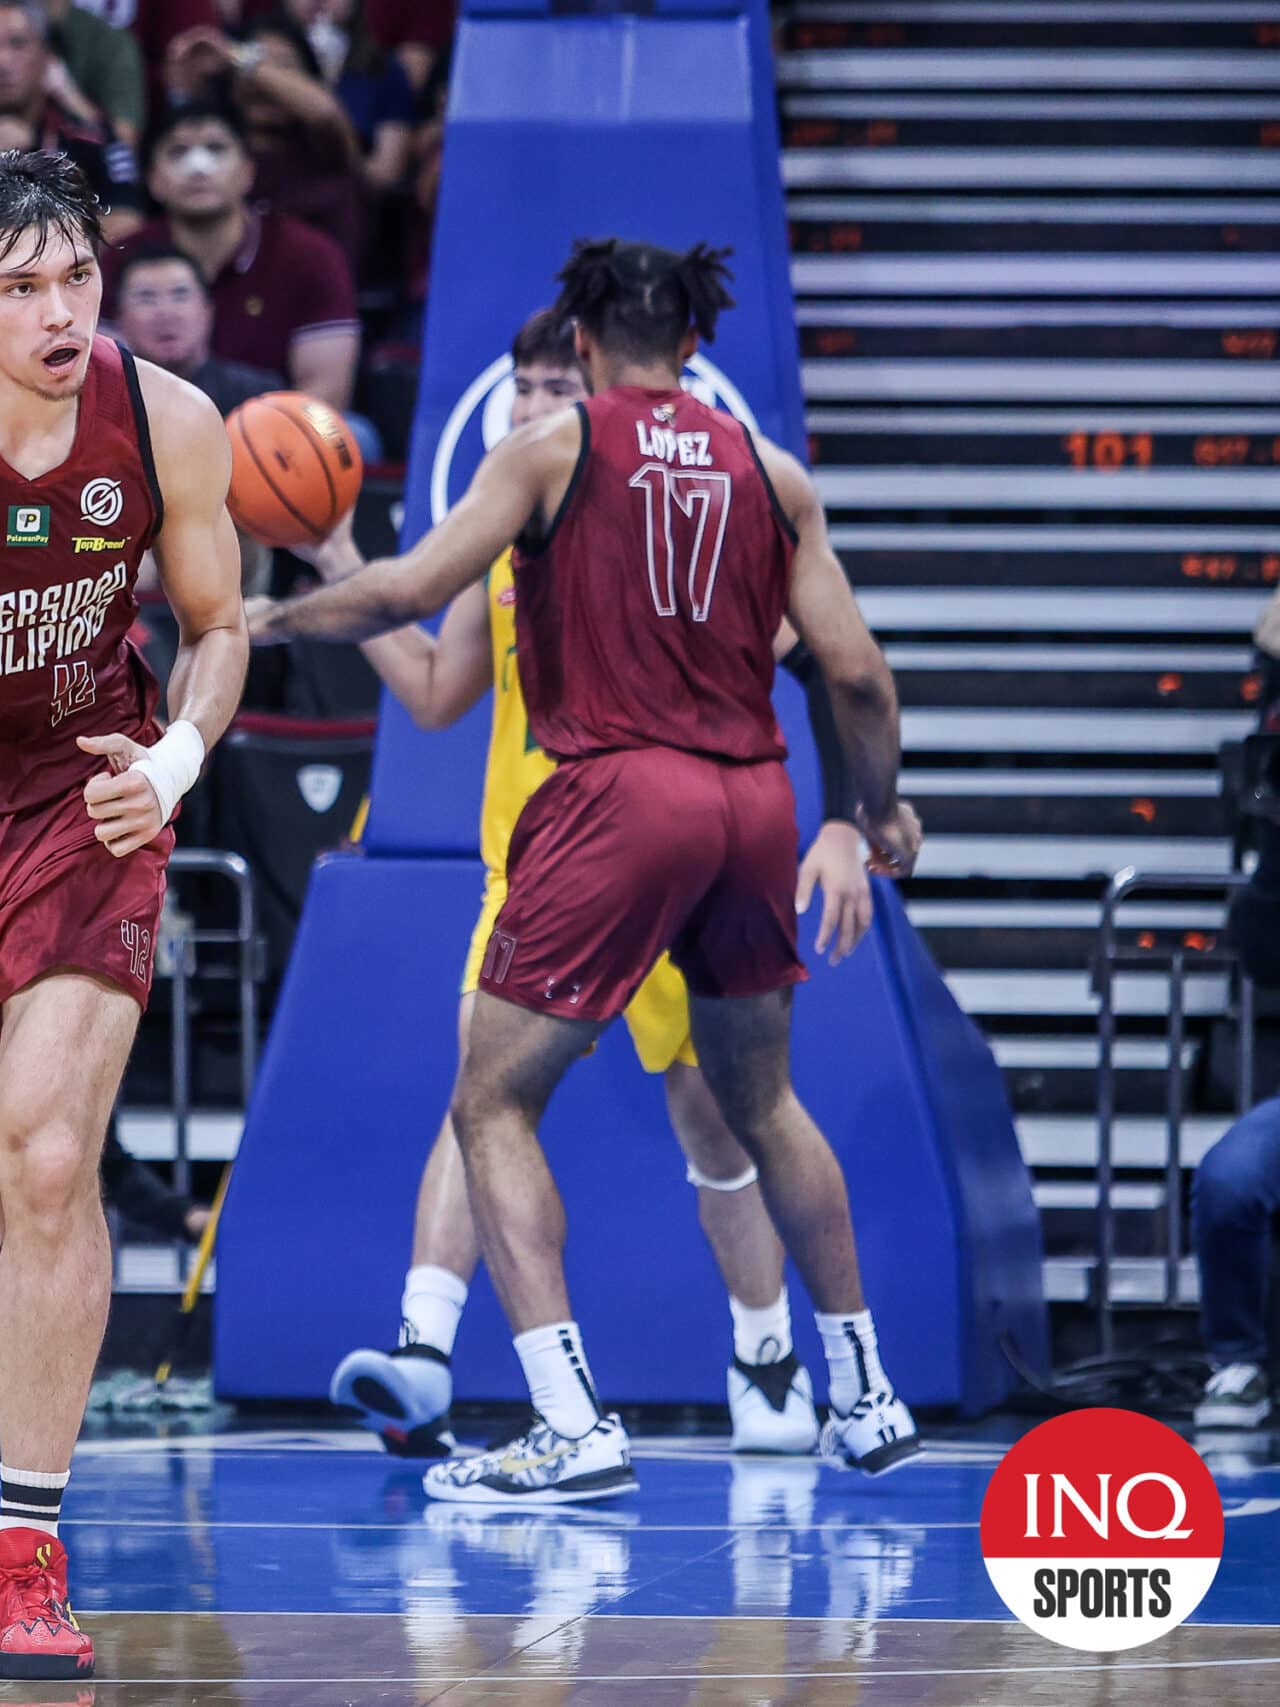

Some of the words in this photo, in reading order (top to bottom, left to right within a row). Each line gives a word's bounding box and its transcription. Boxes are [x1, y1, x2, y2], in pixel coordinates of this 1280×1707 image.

[635, 420, 713, 466] LOPEZ
[1065, 431, 1153, 473] 101
[628, 462, 731, 621] 17
[121, 919, 150, 984] 42
